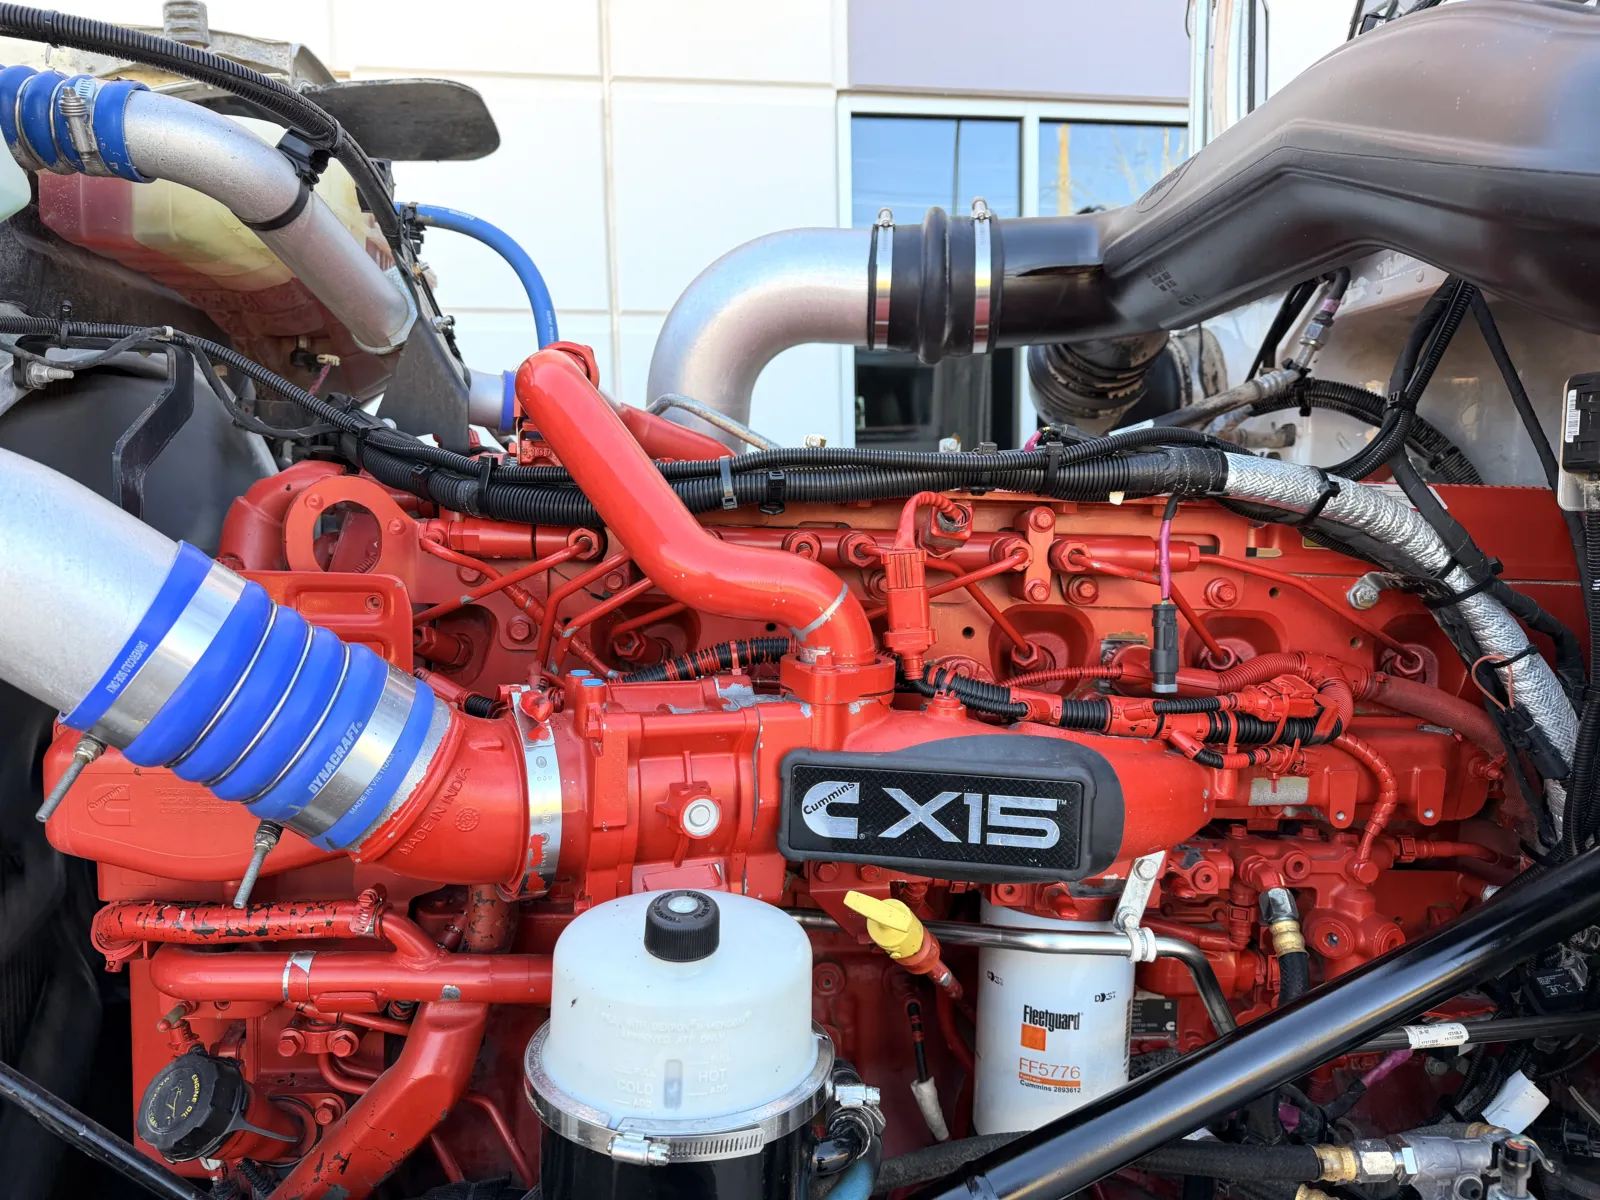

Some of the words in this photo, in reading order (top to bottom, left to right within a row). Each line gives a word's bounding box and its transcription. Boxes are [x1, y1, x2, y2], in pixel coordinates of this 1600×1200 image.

[308, 722, 360, 795] DYNACRAFT
[350, 794, 367, 815] MADE
[365, 785, 374, 797] IN
[371, 753, 395, 788] VIETNAM
[803, 781, 855, 816] Cummins
[399, 819, 434, 855] MADE
[430, 806, 447, 822] IN
[441, 766, 471, 805] INDIA
[878, 787, 1061, 849] X15
[1023, 1004, 1080, 1032] Fleetguard
[633, 1067, 656, 1077] FULL
[699, 1068, 728, 1083] HOT
[1019, 1057, 1080, 1079] FF5776
[191, 1074, 200, 1103] ENGINE
[616, 1079, 654, 1095] COLD
[709, 1084, 729, 1094] ADD
[1020, 1079, 1052, 1092] Cummins
[181, 1105, 193, 1119] OIL
[633, 1098, 652, 1108] ADD
